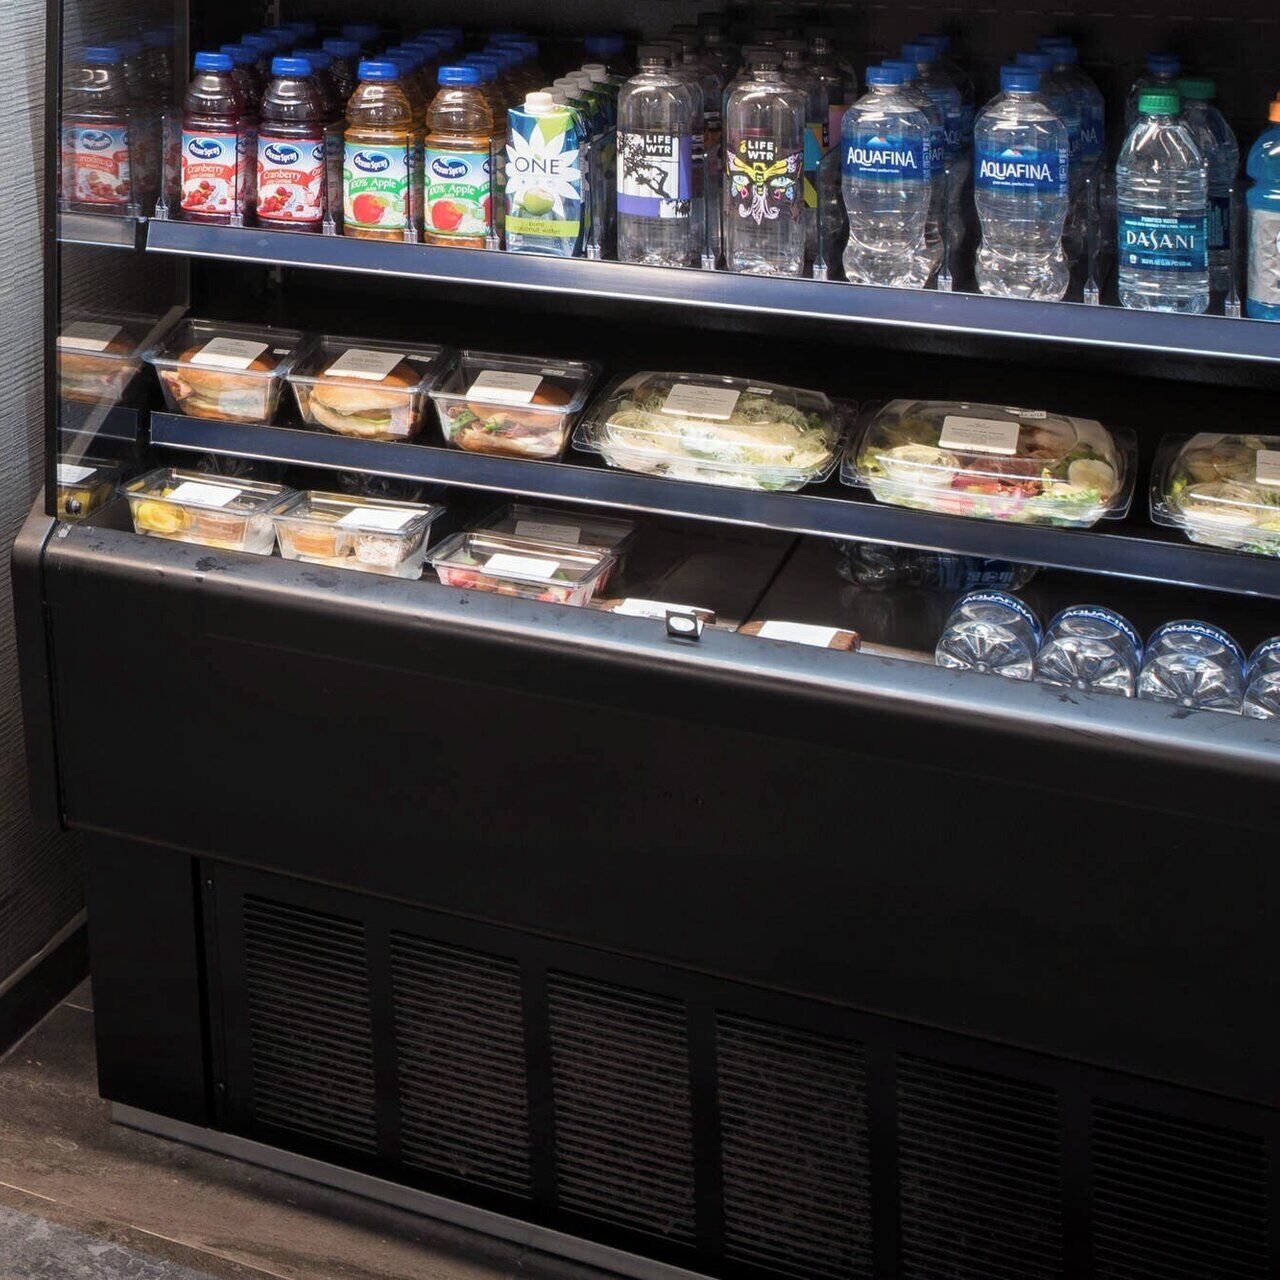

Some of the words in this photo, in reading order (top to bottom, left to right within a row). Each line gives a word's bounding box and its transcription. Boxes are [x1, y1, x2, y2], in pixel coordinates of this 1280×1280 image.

[646, 135, 671, 145] LIFE
[748, 141, 774, 151] LIFE
[189, 145, 205, 155] Ocean
[204, 148, 220, 158] Spray
[266, 150, 281, 160] Ocean
[280, 152, 297, 163] Spray
[646, 145, 672, 155] WTR
[748, 150, 774, 160] WTR
[355, 158, 371, 169] Ocean
[371, 159, 388, 170] Spray
[847, 147, 917, 169] AQUAFINA
[187, 164, 224, 175] Cranberry
[433, 163, 449, 174] Ocean
[448, 165, 466, 176] Spray
[515, 157, 559, 175] ONE
[980, 160, 1053, 182] AQUAFINA
[263, 170, 302, 181] Cranberry
[370, 178, 397, 189] Apple
[448, 185, 475, 195] Apple
[1126, 229, 1194, 250] DASANI
[961, 594, 1035, 625] AQUAFINA
[1061, 609, 1136, 642] AQUAFINA
[1159, 624, 1238, 656] AQUAFINA
